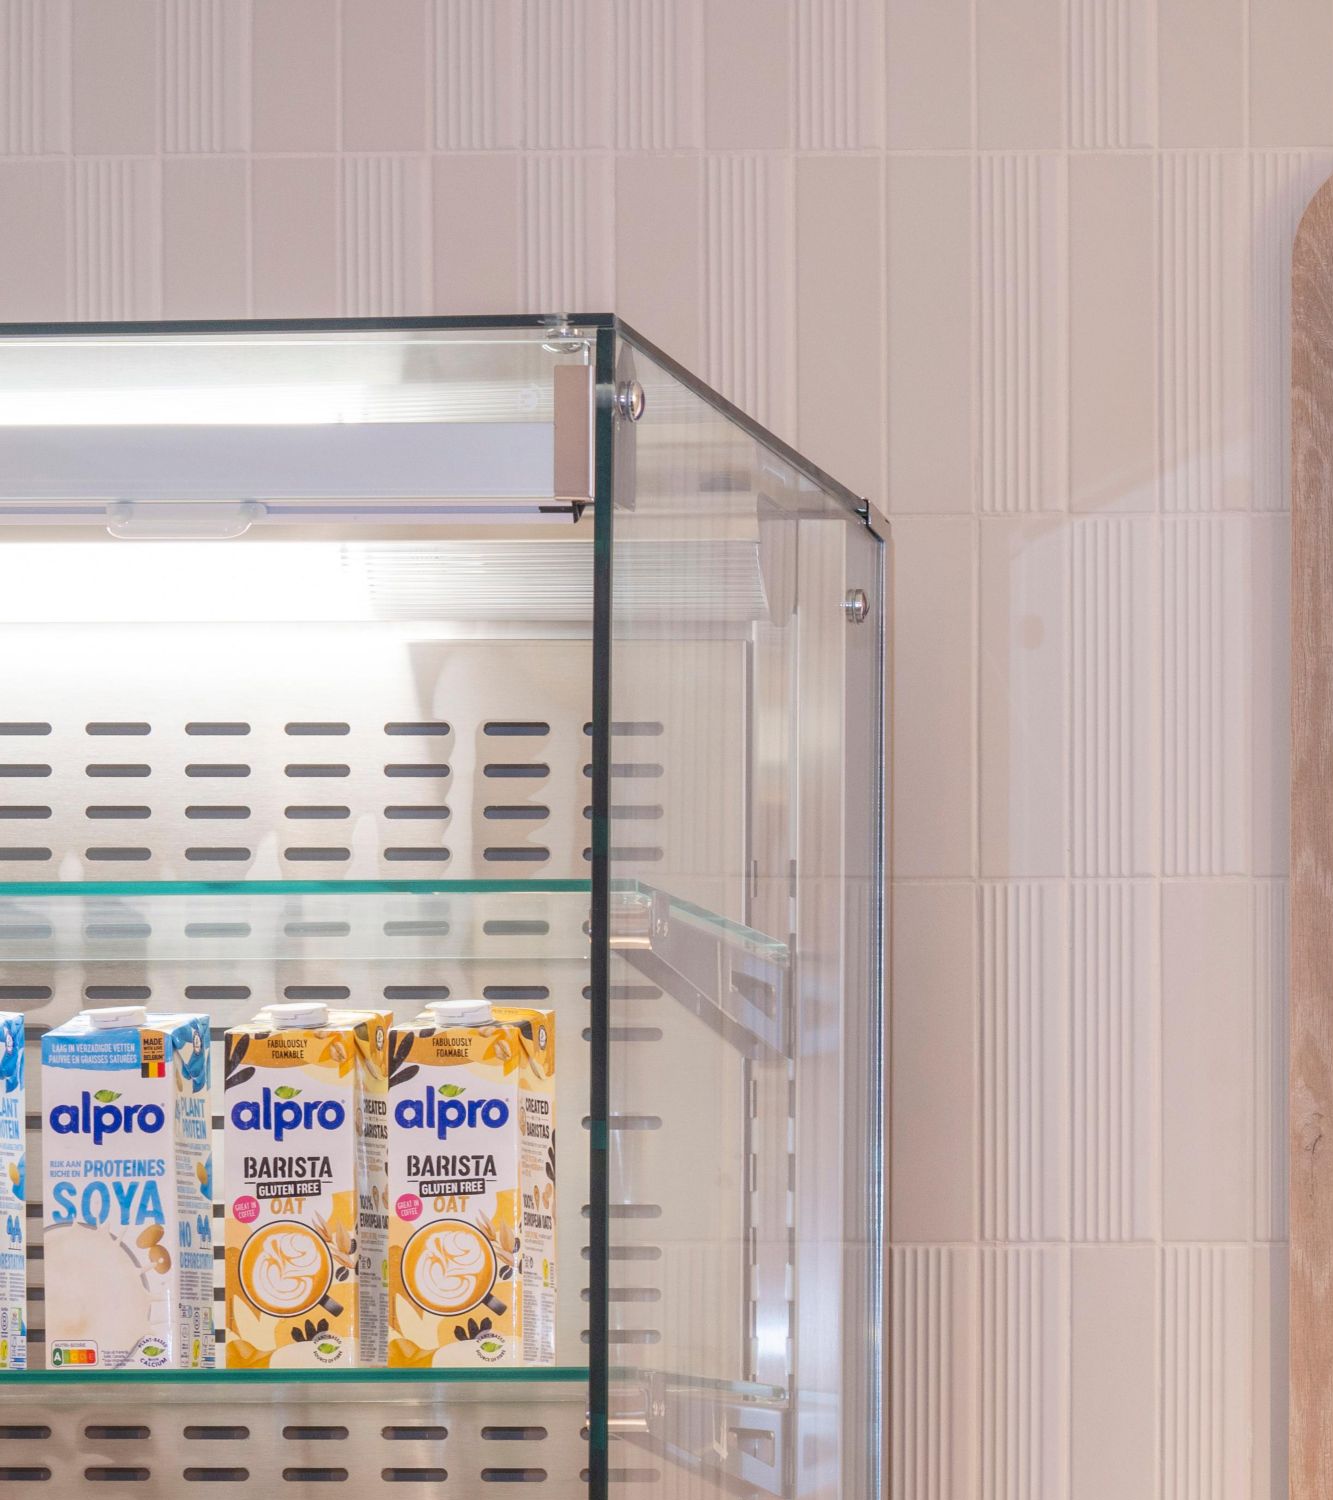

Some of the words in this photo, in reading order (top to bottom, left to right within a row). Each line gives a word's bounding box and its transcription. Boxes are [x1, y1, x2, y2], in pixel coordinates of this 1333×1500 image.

[143, 1038, 162, 1046] MADE
[267, 1039, 308, 1048] FABULOUSLY
[432, 1038, 472, 1047] FABULOUSLY
[271, 1050, 304, 1059] FOAMABLE
[436, 1049, 469, 1058] FOAMABLE
[49, 1091, 165, 1145] alpro
[231, 1087, 345, 1142] alpro
[394, 1085, 509, 1140] alpro
[83, 1159, 165, 1177] PROTEINES
[244, 1156, 333, 1179] BARISTA
[407, 1154, 497, 1177] BARISTA
[258, 1184, 295, 1197] GLUTEN
[296, 1182, 320, 1195] FREE
[421, 1182, 458, 1195] GLUTEN
[460, 1181, 484, 1193] FREE
[51, 1180, 166, 1226] SOYA
[270, 1198, 306, 1215] OAT
[433, 1196, 470, 1213] OAT
